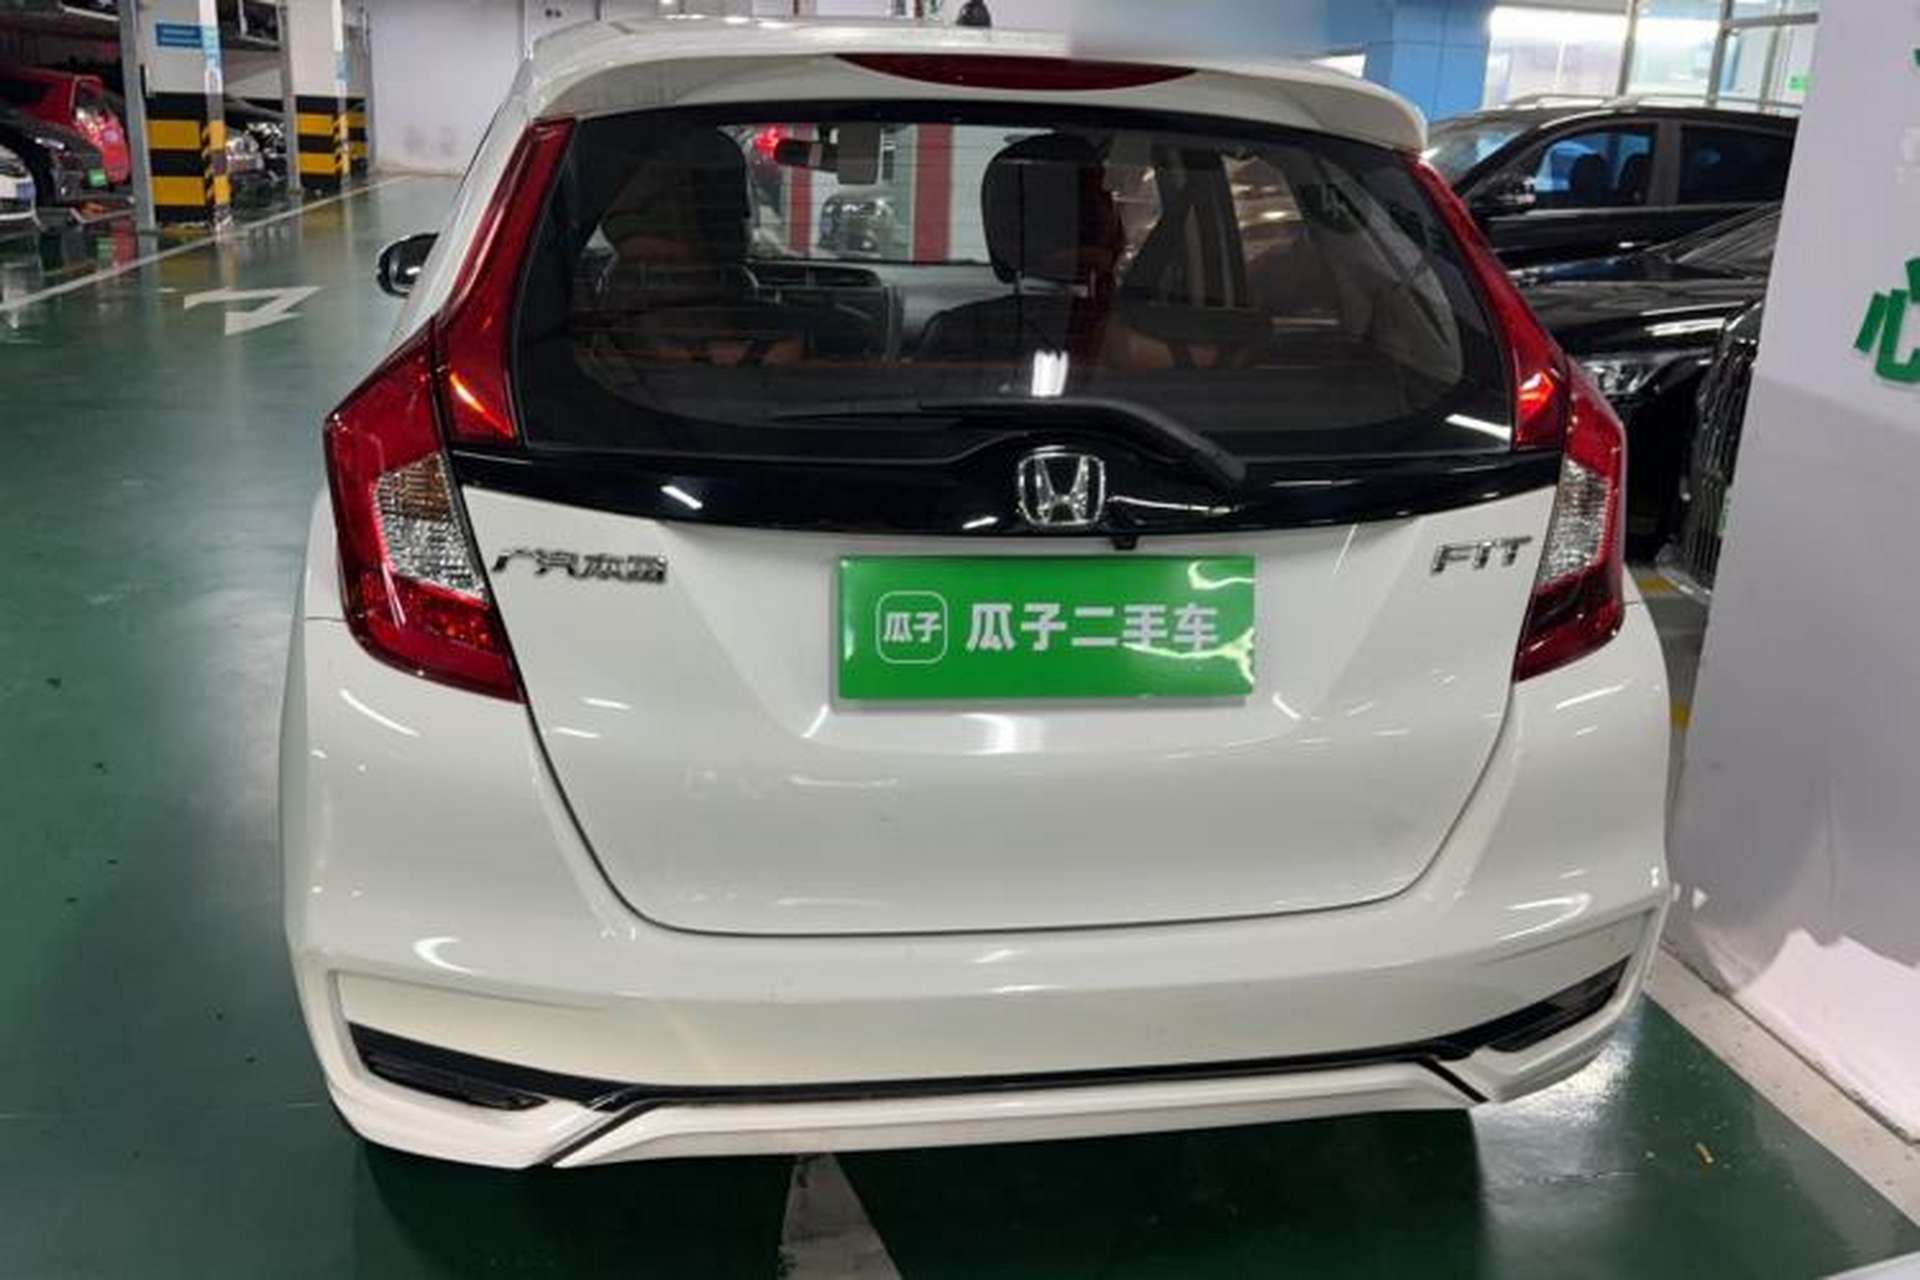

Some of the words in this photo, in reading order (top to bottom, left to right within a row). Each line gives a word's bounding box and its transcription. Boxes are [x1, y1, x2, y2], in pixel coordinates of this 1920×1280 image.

[1430, 535, 1533, 575] FIT
[883, 611, 942, 644] 瓜子
[966, 602, 1220, 652] 瓜子二手车
